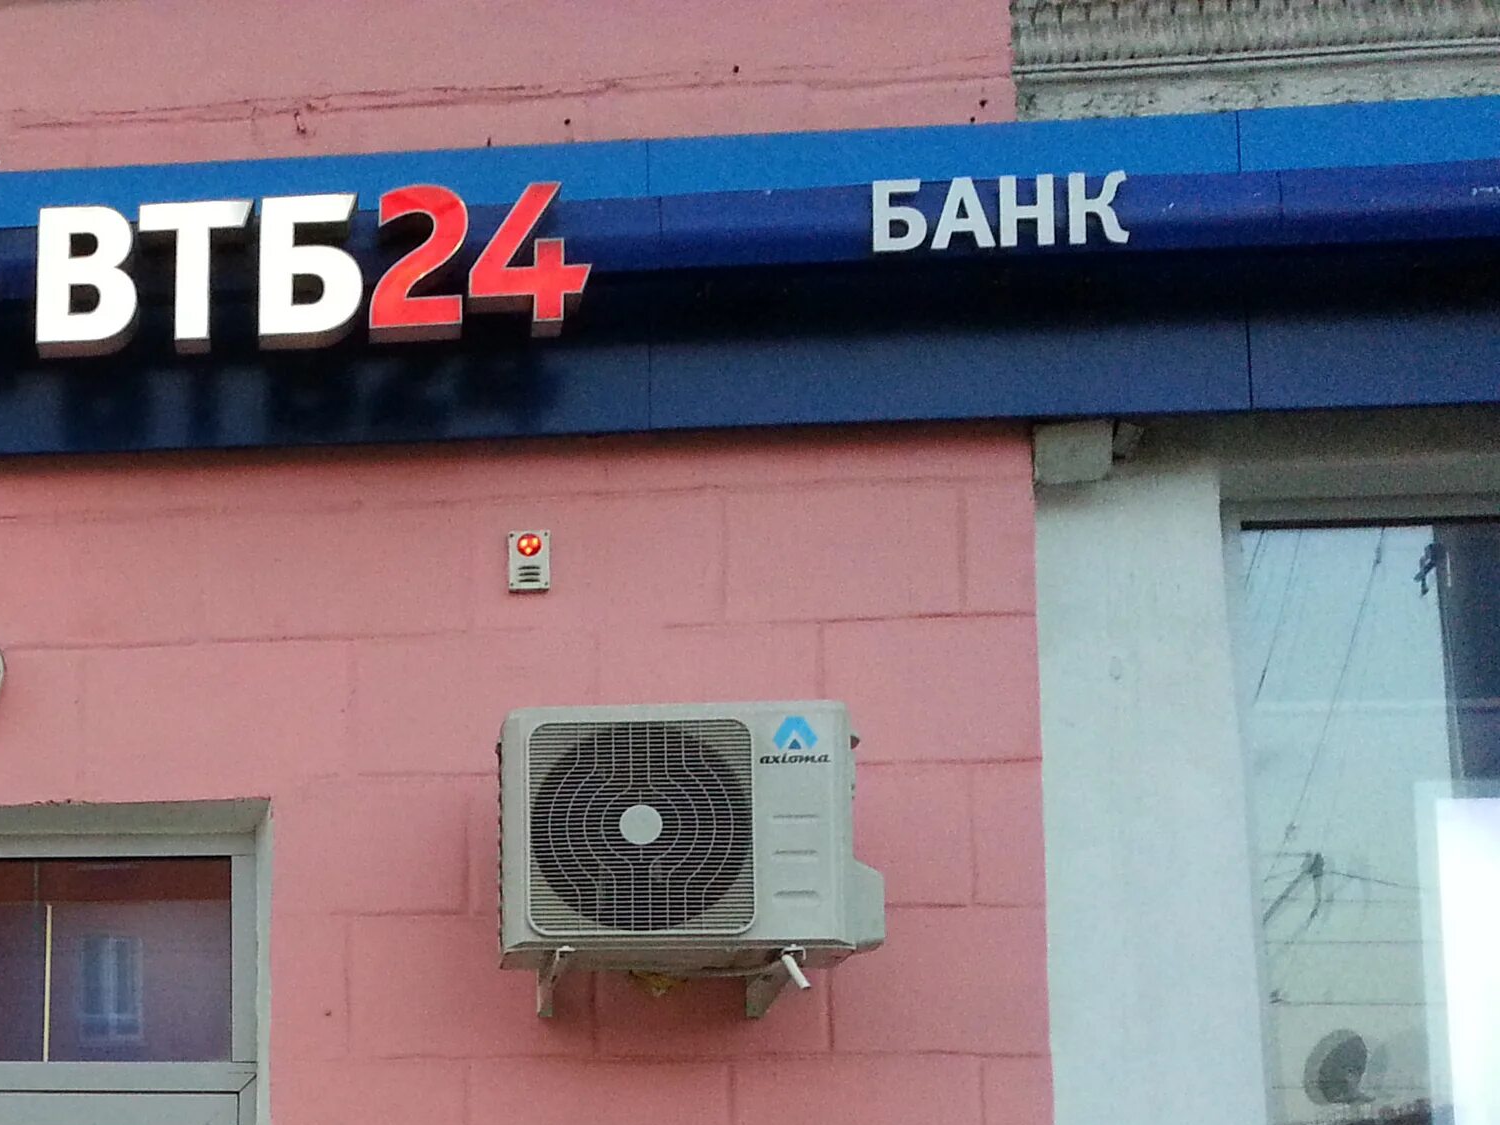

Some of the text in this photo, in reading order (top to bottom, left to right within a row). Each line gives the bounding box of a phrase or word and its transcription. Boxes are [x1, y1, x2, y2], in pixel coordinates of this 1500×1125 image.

[872, 170, 1130, 253] БАНК
[35, 181, 592, 354] ВТБ24
[759, 752, 831, 764] axioma
